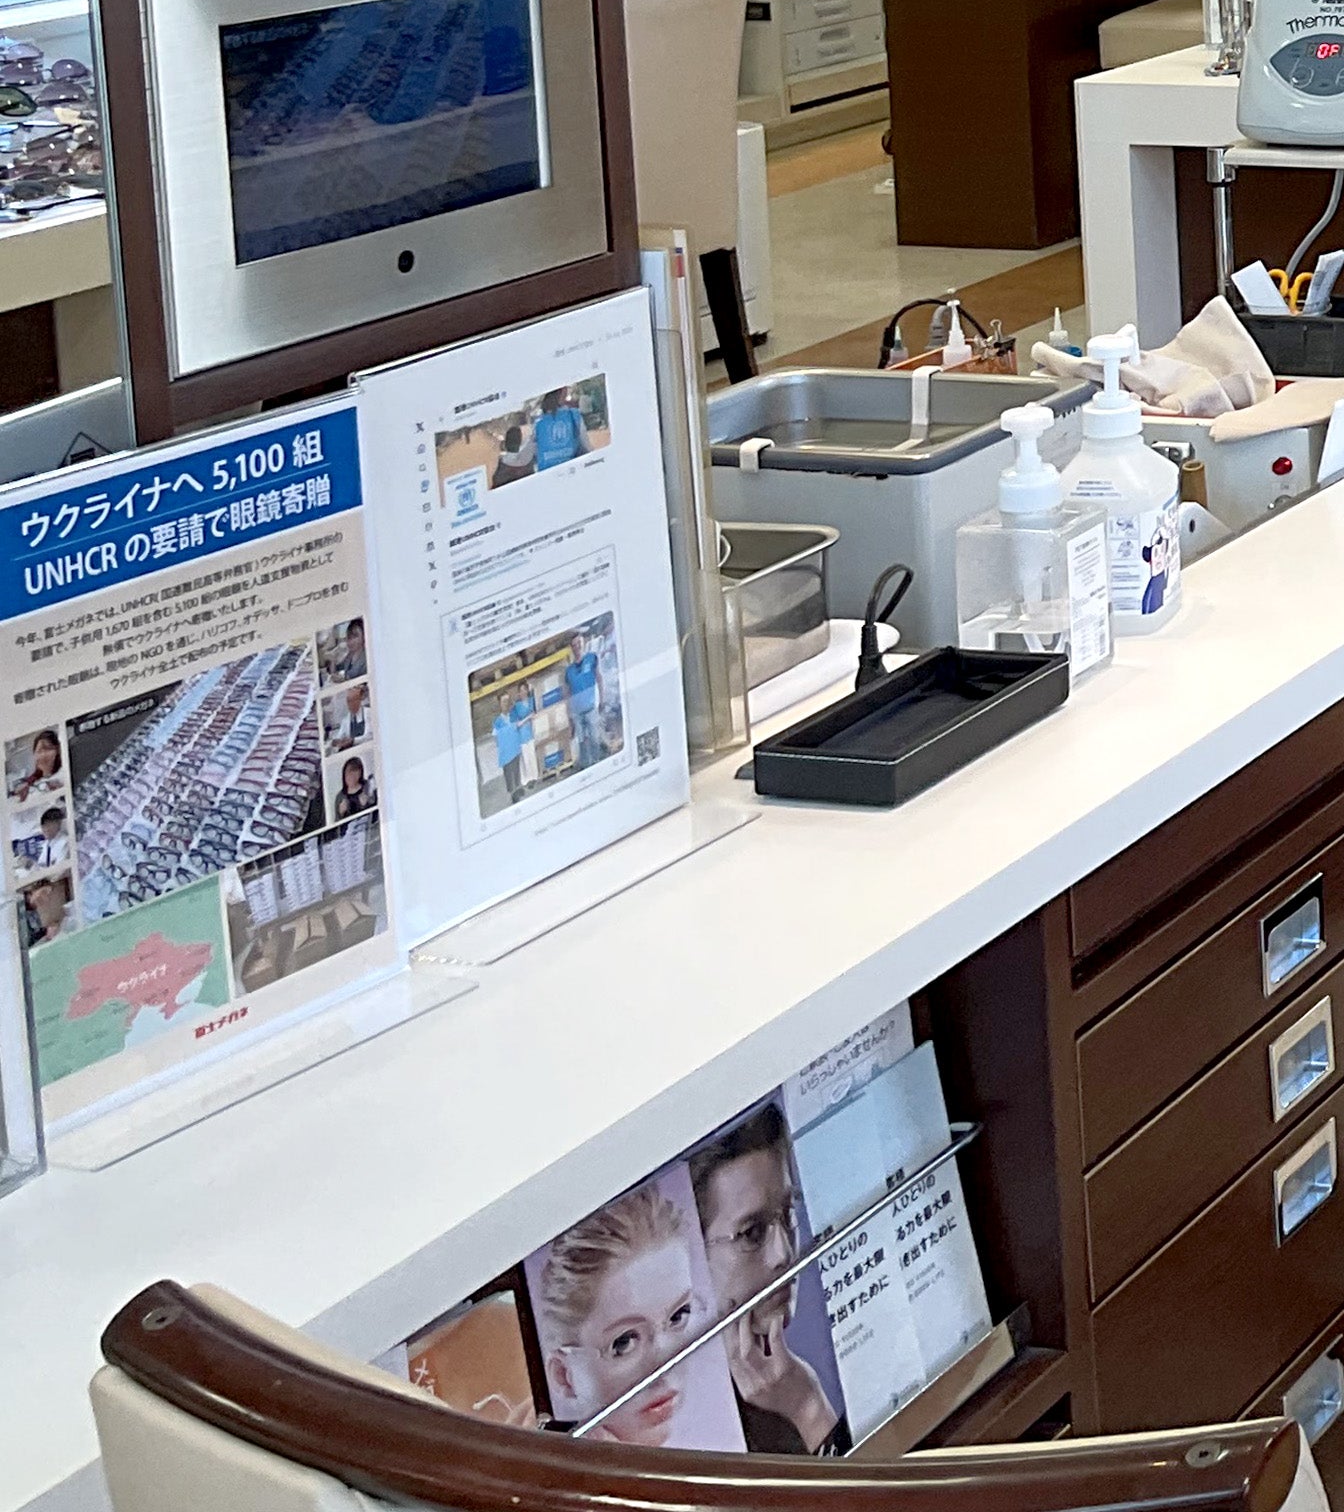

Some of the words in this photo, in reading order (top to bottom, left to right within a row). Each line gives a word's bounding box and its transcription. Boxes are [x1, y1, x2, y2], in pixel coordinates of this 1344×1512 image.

[21, 473, 203, 547] ウクライナへ
[212, 443, 285, 490] 5,100
[292, 429, 324, 468] 組
[25, 545, 118, 596] UNHCR
[125, 473, 331, 563] の要請で眼鏡寄贈
[195, 1006, 249, 1038] 富士メガネ
